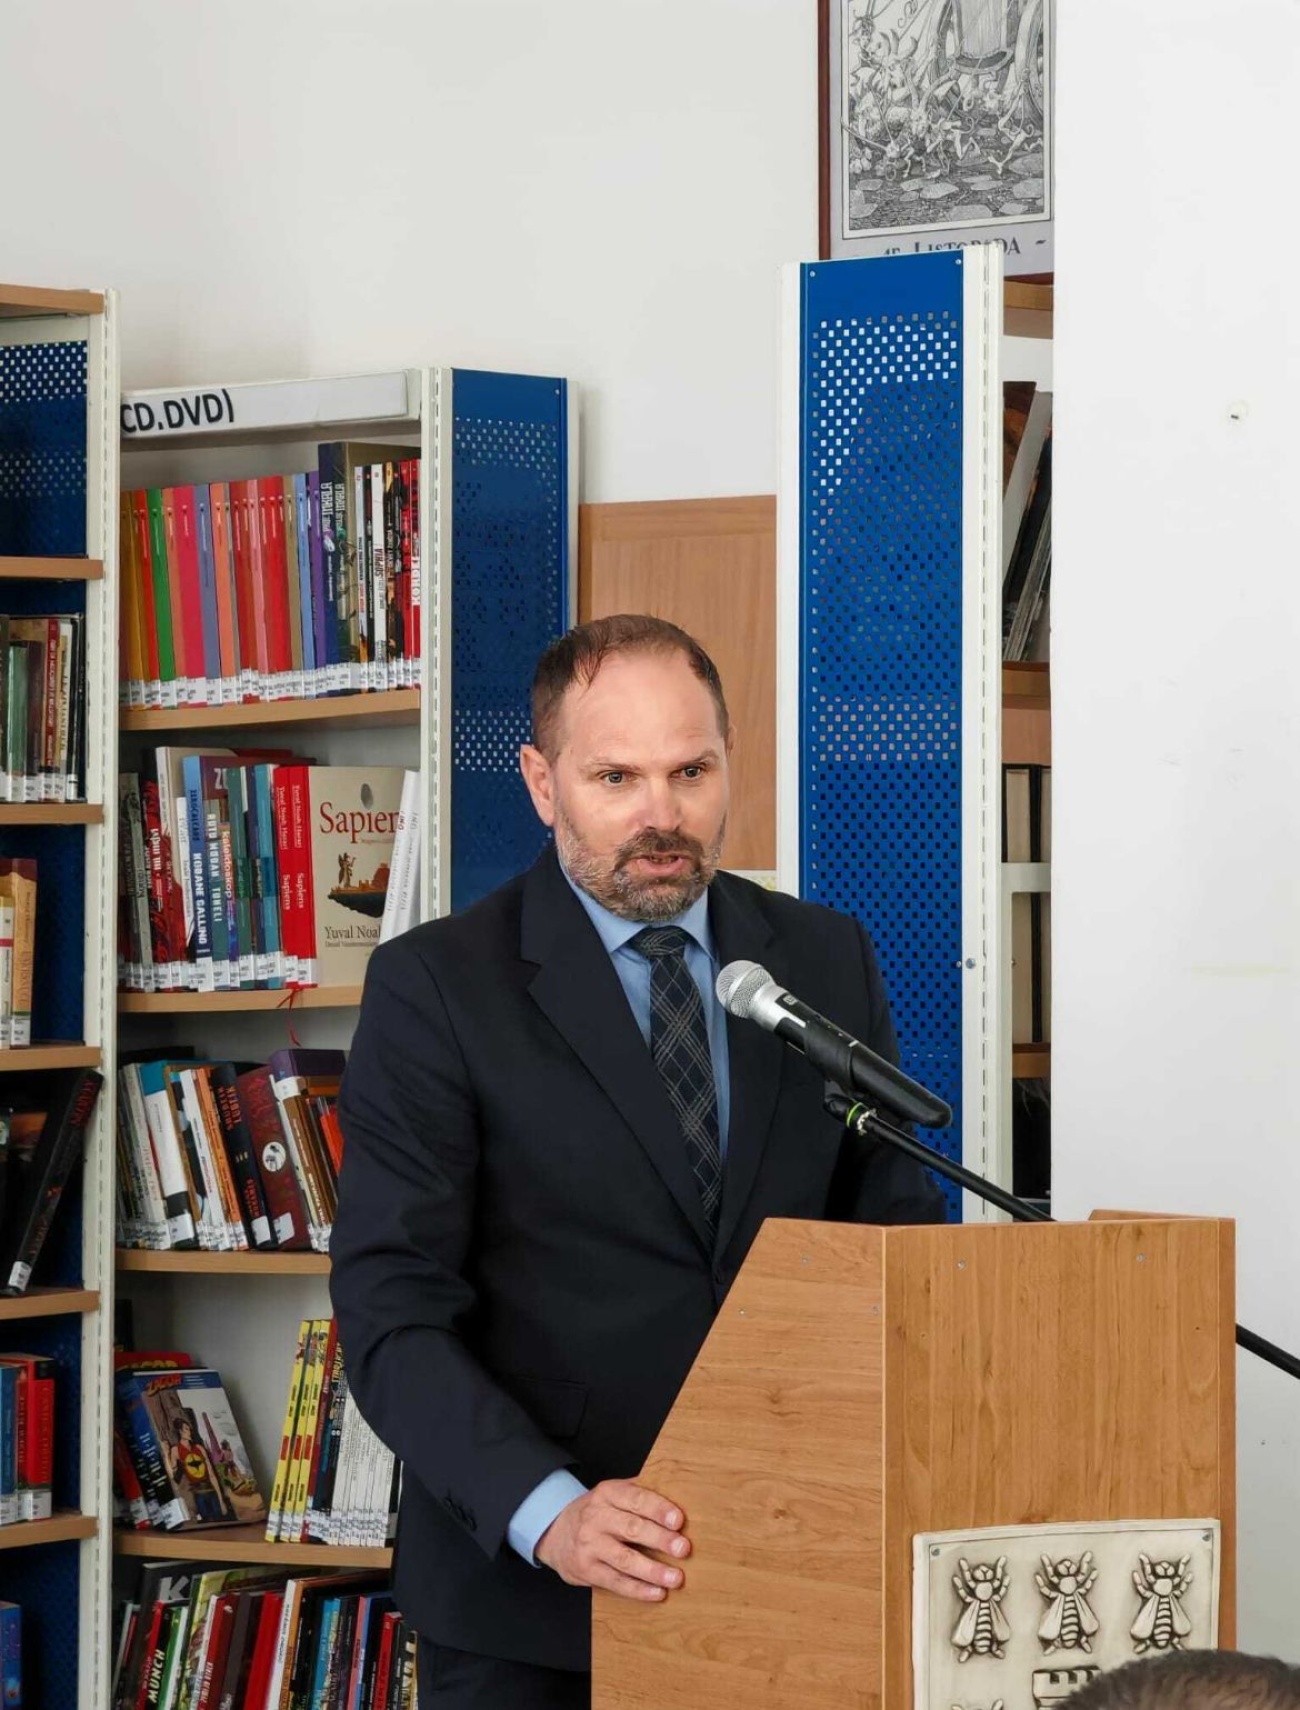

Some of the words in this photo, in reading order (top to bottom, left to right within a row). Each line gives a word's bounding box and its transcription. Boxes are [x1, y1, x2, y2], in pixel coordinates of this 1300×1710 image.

[374, 548, 384, 577] SOPHIA
[193, 852, 205, 897] KOBANE
[281, 874, 292, 910] Sapiens
[295, 872, 307, 909] Sapiens
[324, 926, 354, 941] Yuval
[148, 1648, 166, 1703] MUNCH
